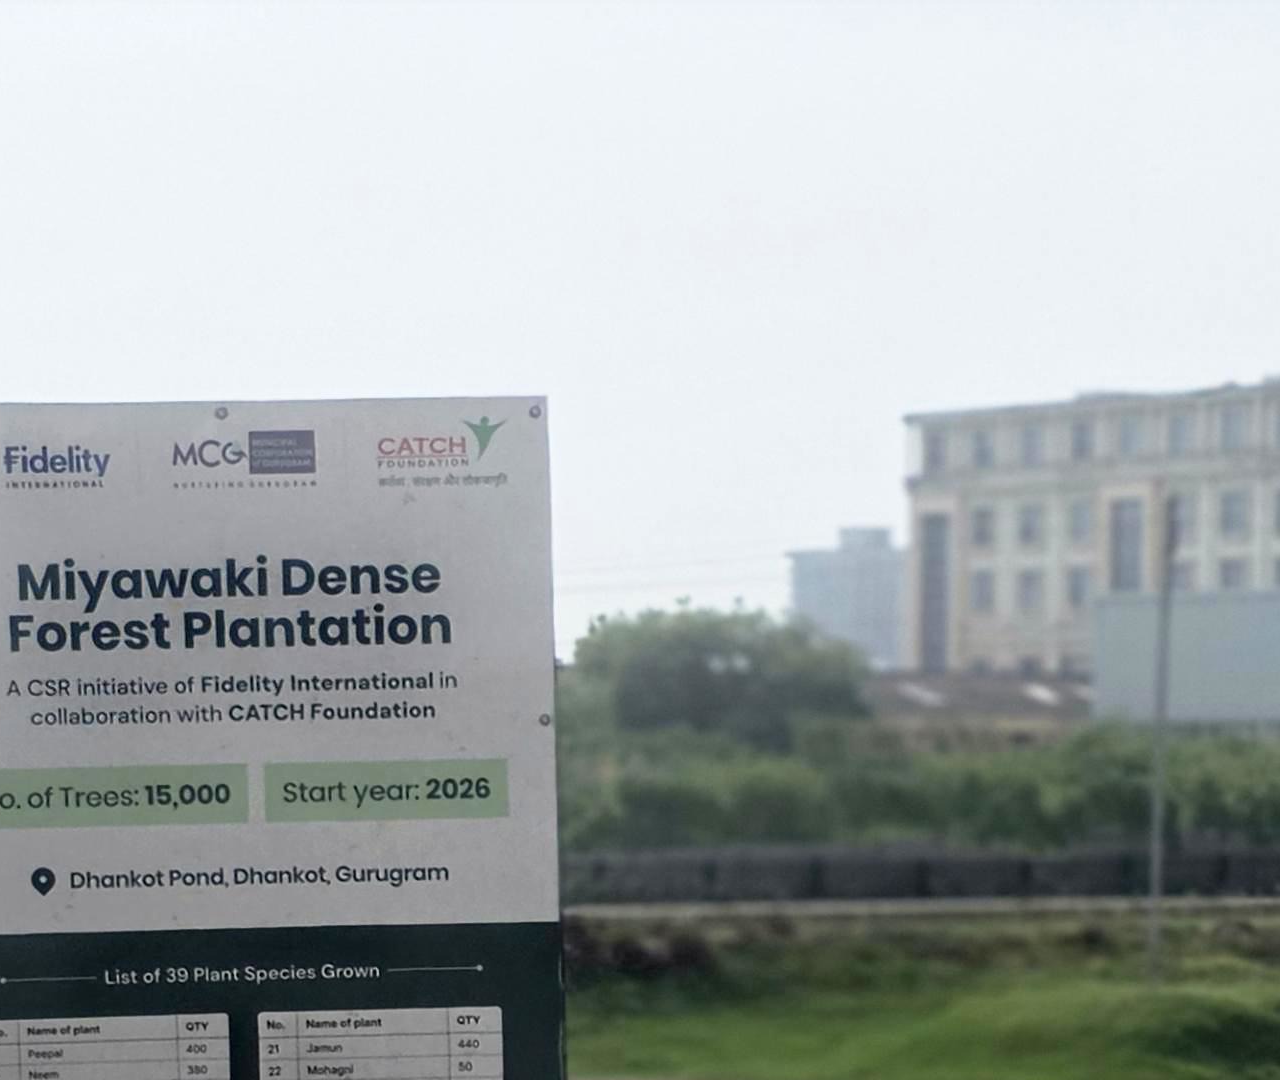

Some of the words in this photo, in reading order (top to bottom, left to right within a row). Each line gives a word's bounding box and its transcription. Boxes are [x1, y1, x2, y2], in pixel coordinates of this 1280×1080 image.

[172, 440, 248, 467] MCG
[377, 436, 466, 455] CATCH
[3, 445, 111, 477] Fidelity
[377, 458, 469, 469] FOUNDATION
[6, 480, 104, 489] INTERNATIONAL
[17, 556, 268, 614] Miyawaki
[282, 560, 441, 597] Dense
[8, 612, 170, 652] Forest
[184, 604, 453, 648] Plantation
[6, 679, 21, 696] A
[27, 678, 71, 697] CSR
[76, 677, 169, 696] initiative
[174, 675, 195, 694] of
[201, 675, 285, 698] Fidelity
[290, 673, 434, 692] International
[439, 673, 458, 690] in
[30, 705, 171, 726] collaboration
[177, 705, 222, 724] with
[228, 704, 305, 722] CATCH
[310, 701, 436, 720] Foundation
[27, 787, 53, 809] of
[58, 786, 140, 808] Trees:
[144, 783, 230, 810] 15,000
[282, 781, 347, 803] Start
[354, 782, 421, 809] year:
[426, 778, 491, 800] 2026
[70, 869, 165, 889] Dhankot
[168, 868, 230, 890] Pond,
[233, 866, 332, 887] Dhankot,
[335, 864, 449, 889] Gurugram
[103, 968, 139, 985] List
[144, 967, 162, 984] of
[166, 967, 189, 983] 39
[193, 966, 239, 983] Plant
[244, 964, 315, 985] Species
[321, 964, 380, 980] Grown
[27, 1027, 57, 1036] Name
[61, 1026, 70, 1035] of
[73, 1025, 100, 1036] plant
[185, 1022, 209, 1032] QTY
[266, 1020, 286, 1030] No.
[306, 1019, 338, 1029] Name
[341, 1018, 351, 1028] of
[354, 1017, 382, 1029] plant
[457, 1015, 480, 1025] QTY
[27, 1049, 63, 1059] Peepal
[268, 1044, 280, 1054] 21
[307, 1043, 342, 1053] Jamun
[28, 1070, 59, 1079] Neem
[268, 1066, 281, 1076] 22
